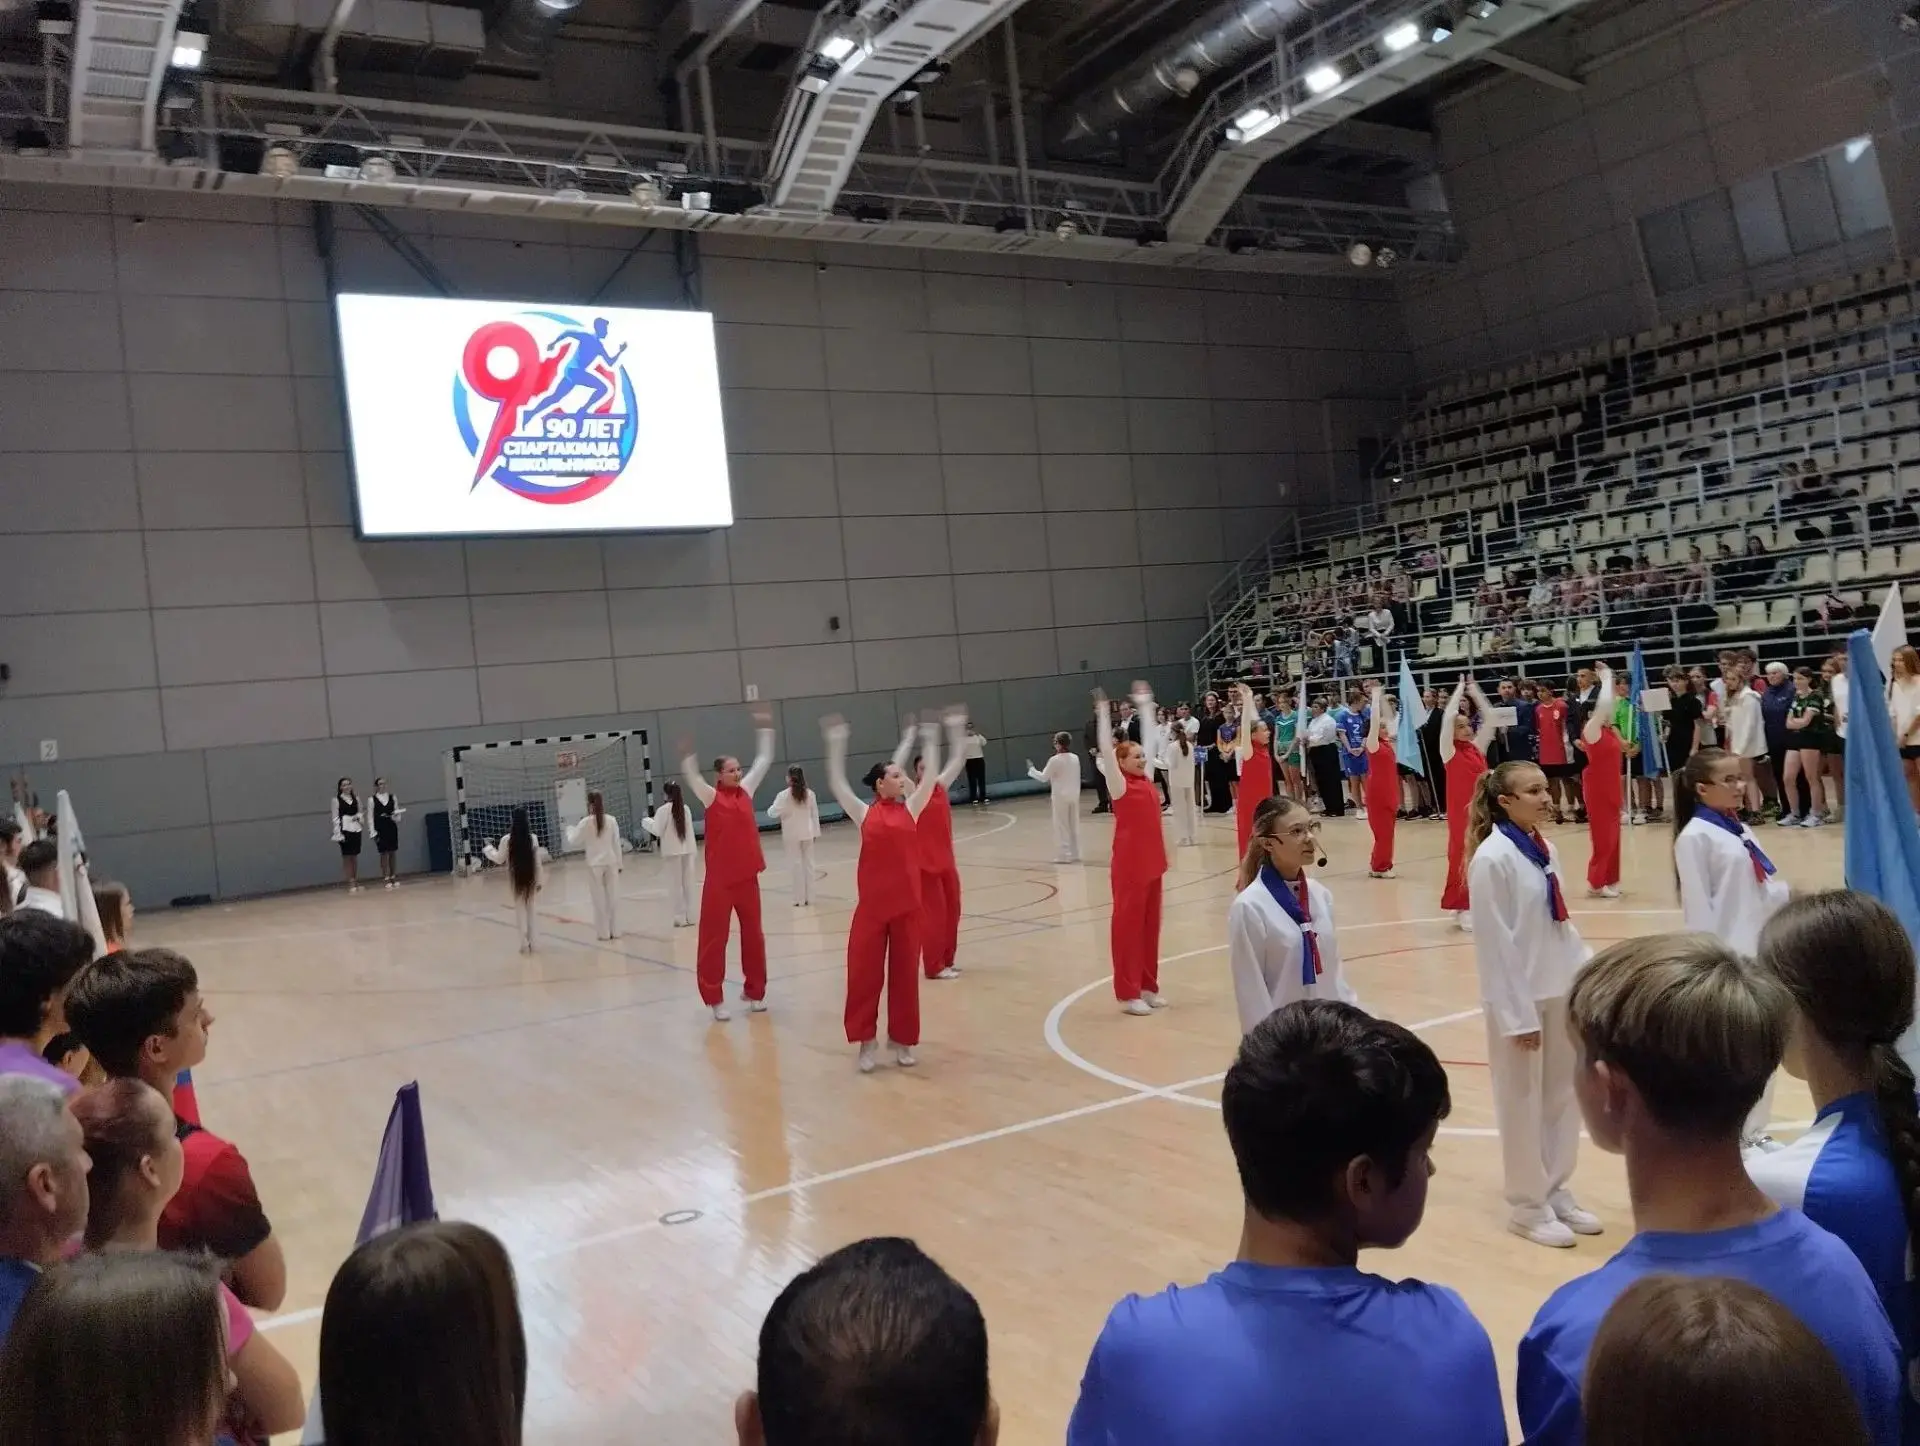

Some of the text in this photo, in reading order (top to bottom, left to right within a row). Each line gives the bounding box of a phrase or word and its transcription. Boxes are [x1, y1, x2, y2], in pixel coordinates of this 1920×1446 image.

[547, 418, 625, 438] 90 ЛЕТ
[504, 441, 619, 457] СПАРТАКИАДА
[1353, 724, 1360, 734] 2
[44, 742, 55, 757] 2
